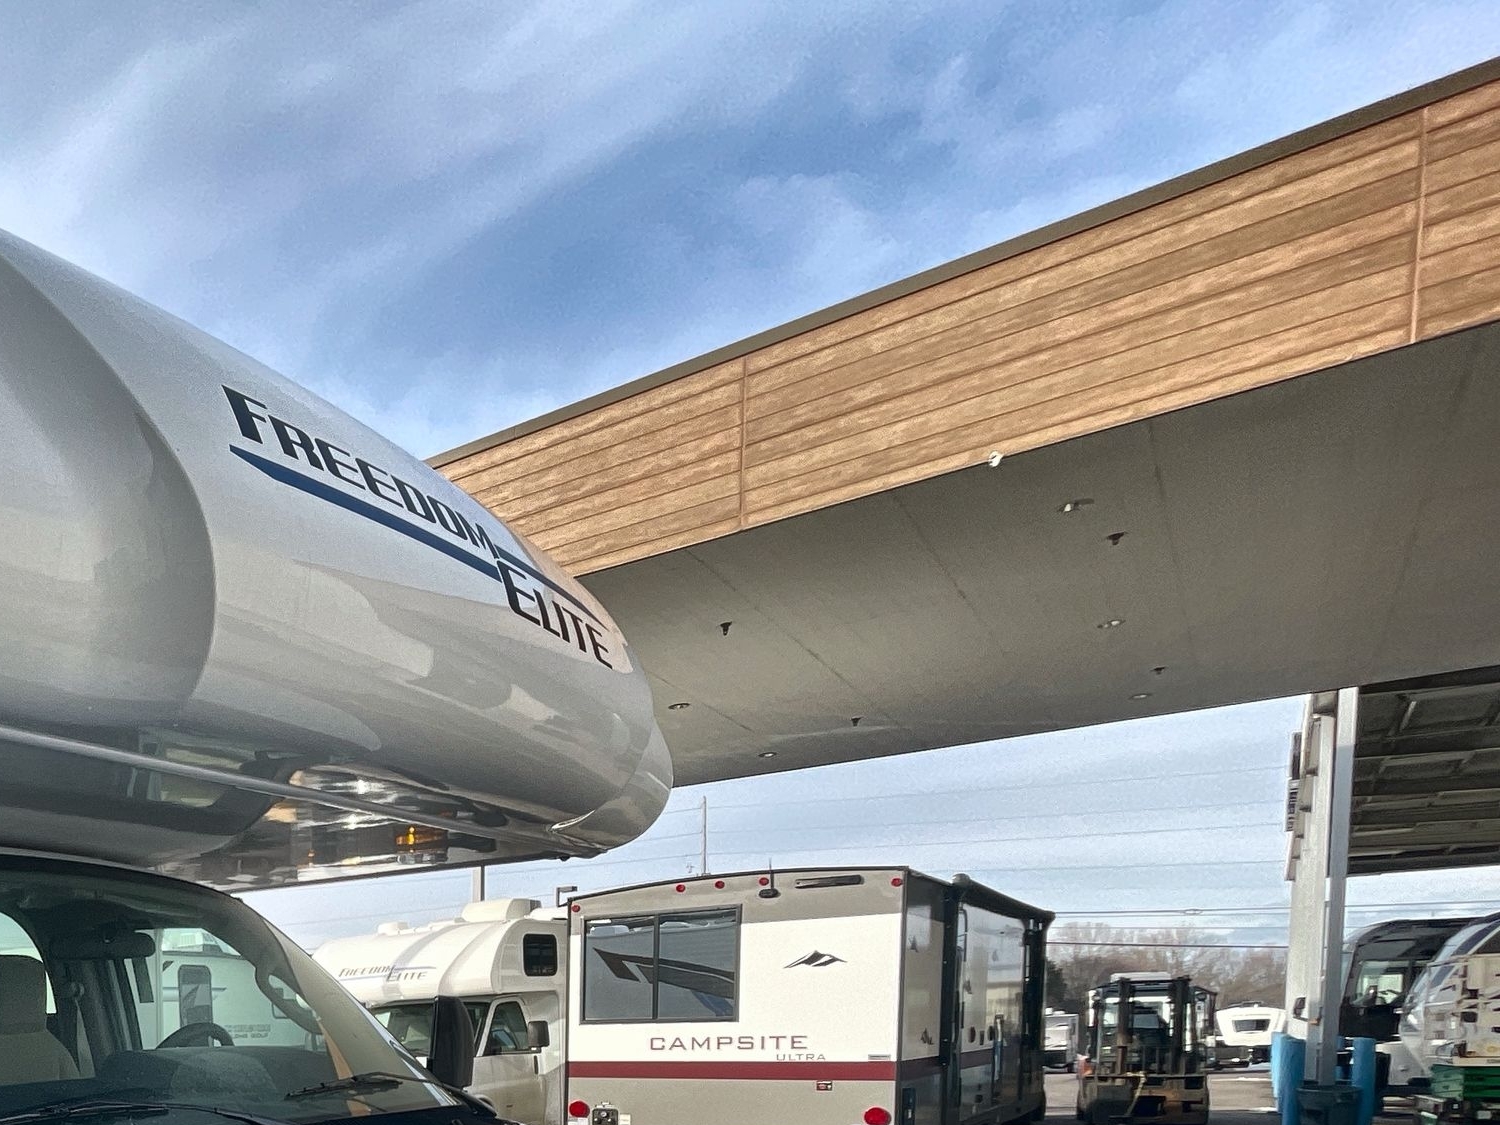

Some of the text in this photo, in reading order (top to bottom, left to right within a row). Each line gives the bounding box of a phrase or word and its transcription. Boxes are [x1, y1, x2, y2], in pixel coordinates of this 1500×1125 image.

[221, 384, 501, 559] FREEDOM
[498, 560, 613, 669] ELITE
[649, 1035, 808, 1051] CAMPSITE
[775, 1053, 826, 1061] ULTRA
